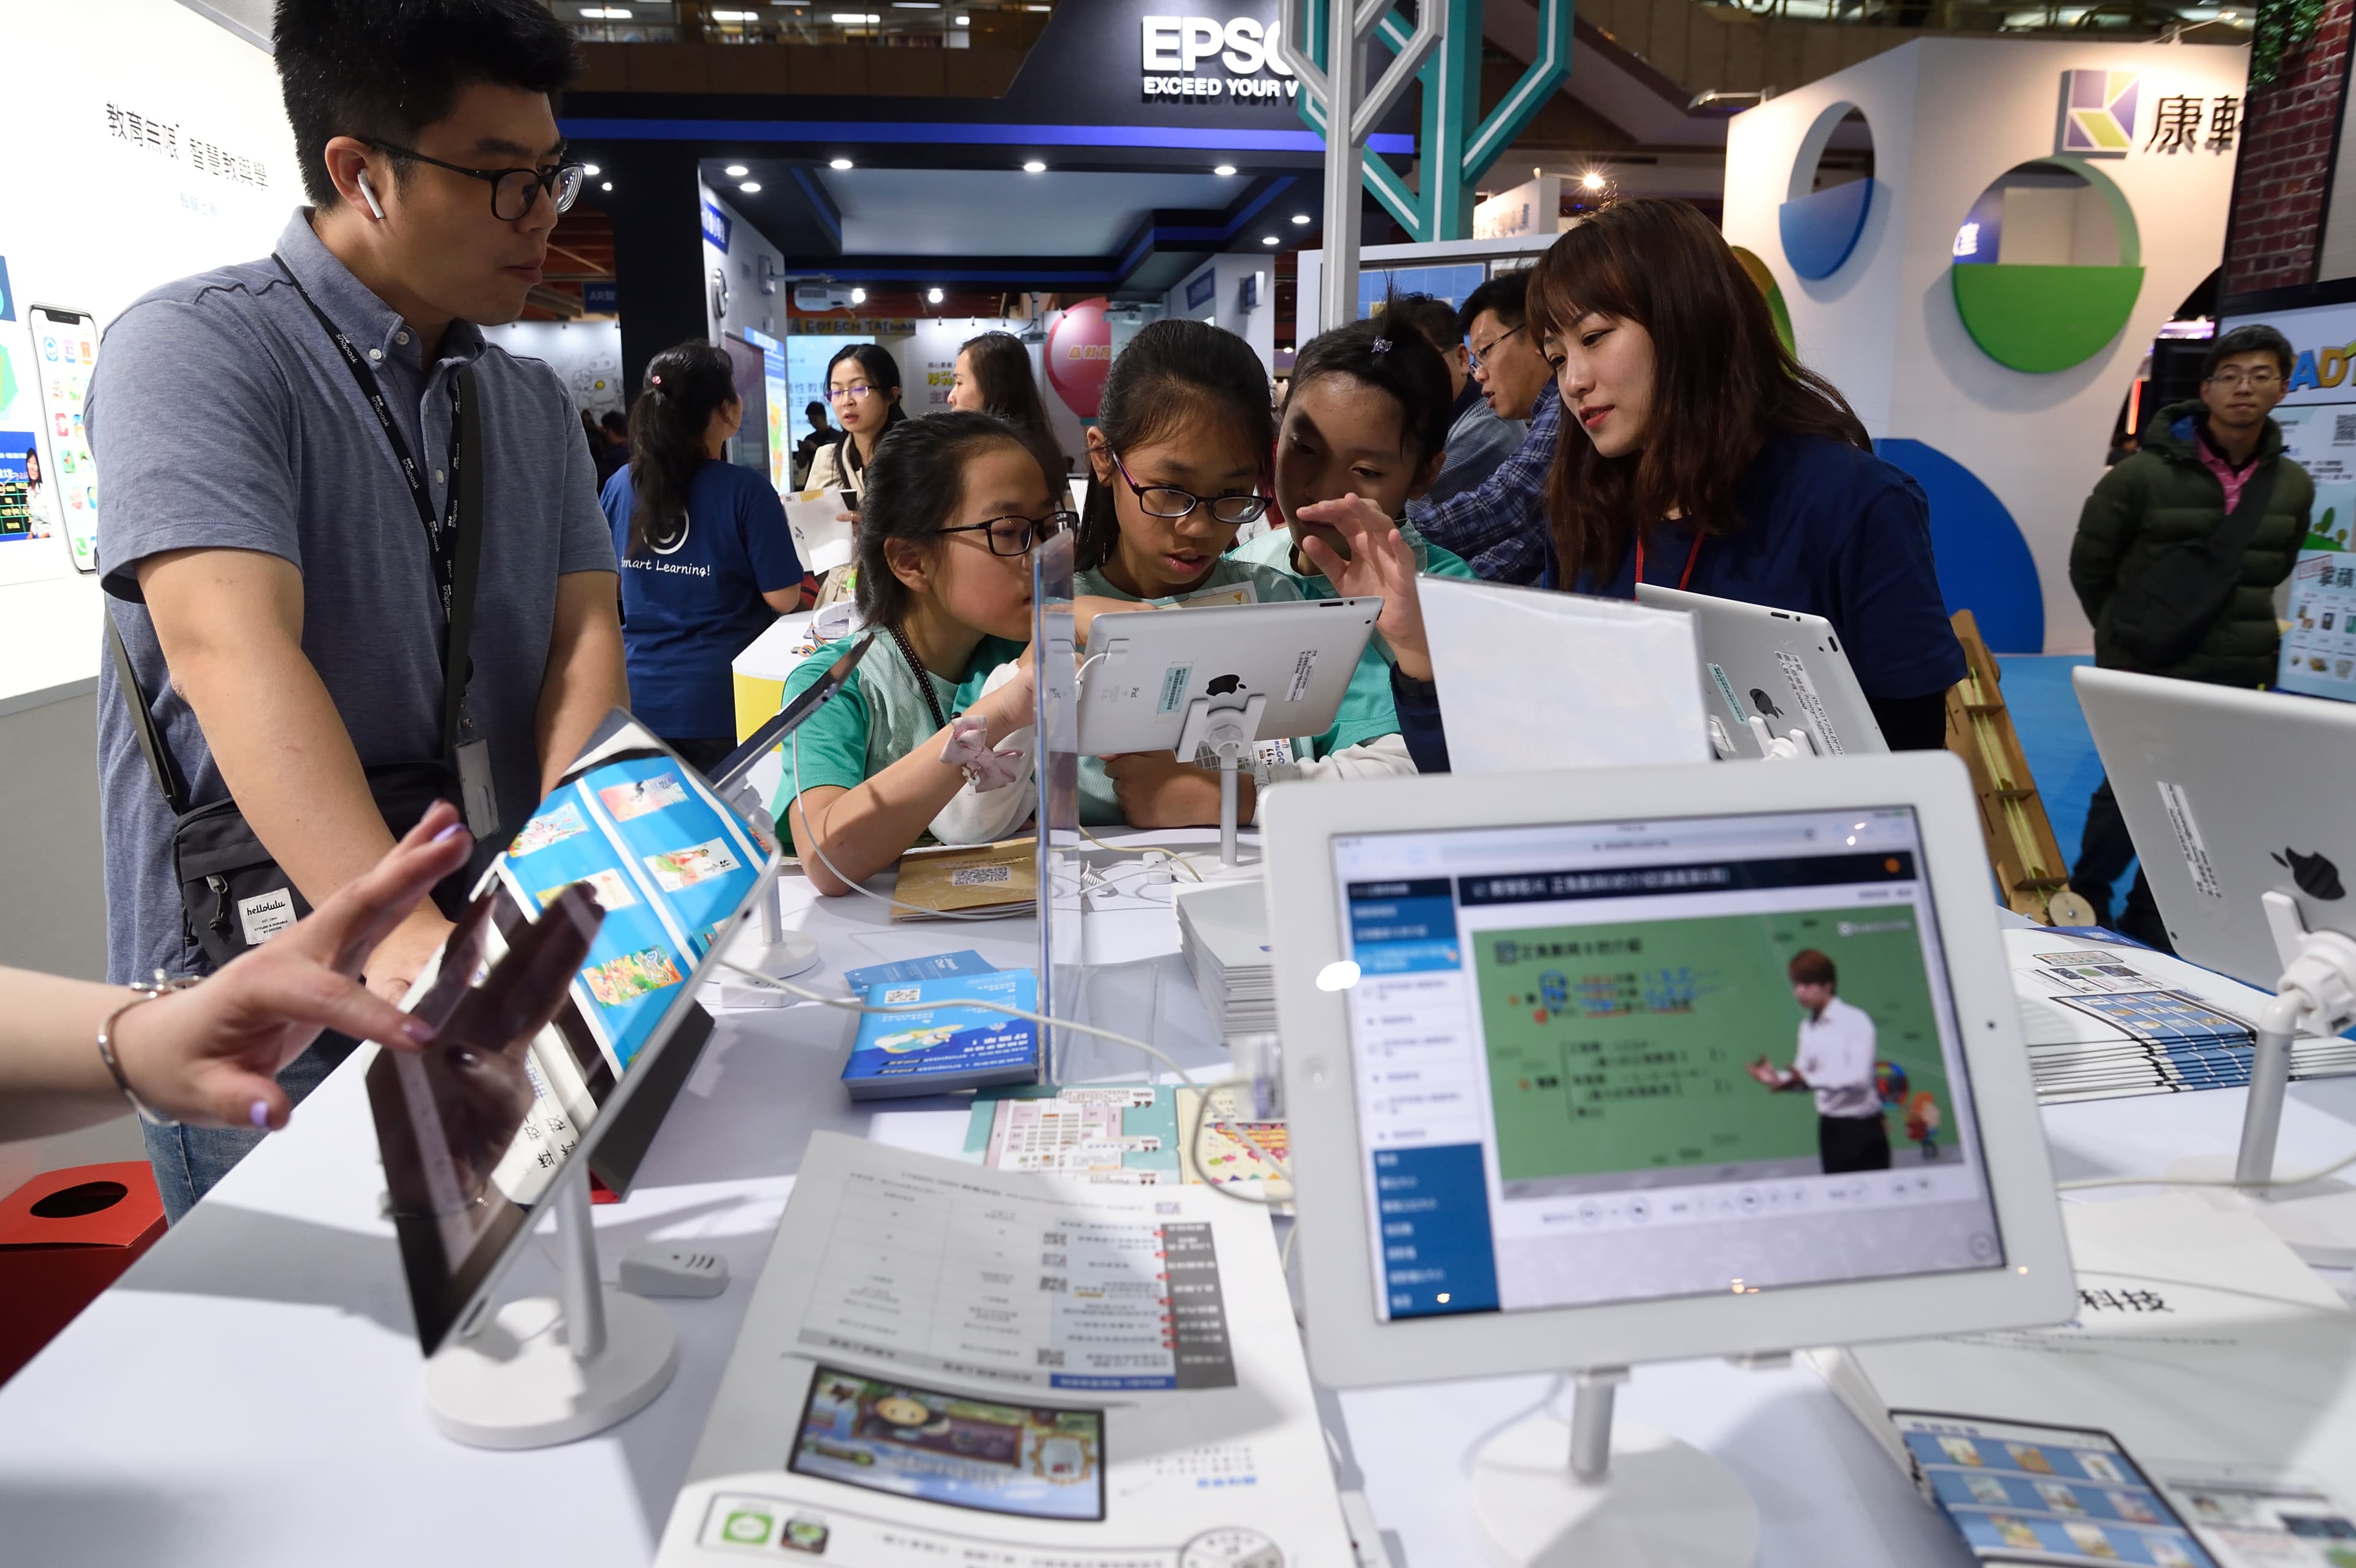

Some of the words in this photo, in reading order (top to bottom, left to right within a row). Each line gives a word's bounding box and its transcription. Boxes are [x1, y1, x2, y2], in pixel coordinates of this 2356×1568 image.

[1143, 76, 1222, 96] EXCEED
[1226, 79, 1280, 97] YOUR
[806, 320, 861, 332] EDTECH
[336, 334, 358, 364] snapask
[371, 395, 390, 428] snapask
[402, 458, 420, 490] snapask
[428, 521, 440, 552] snapask
[656, 559, 710, 577] Learning!
[247, 900, 286, 916] hellolulu
